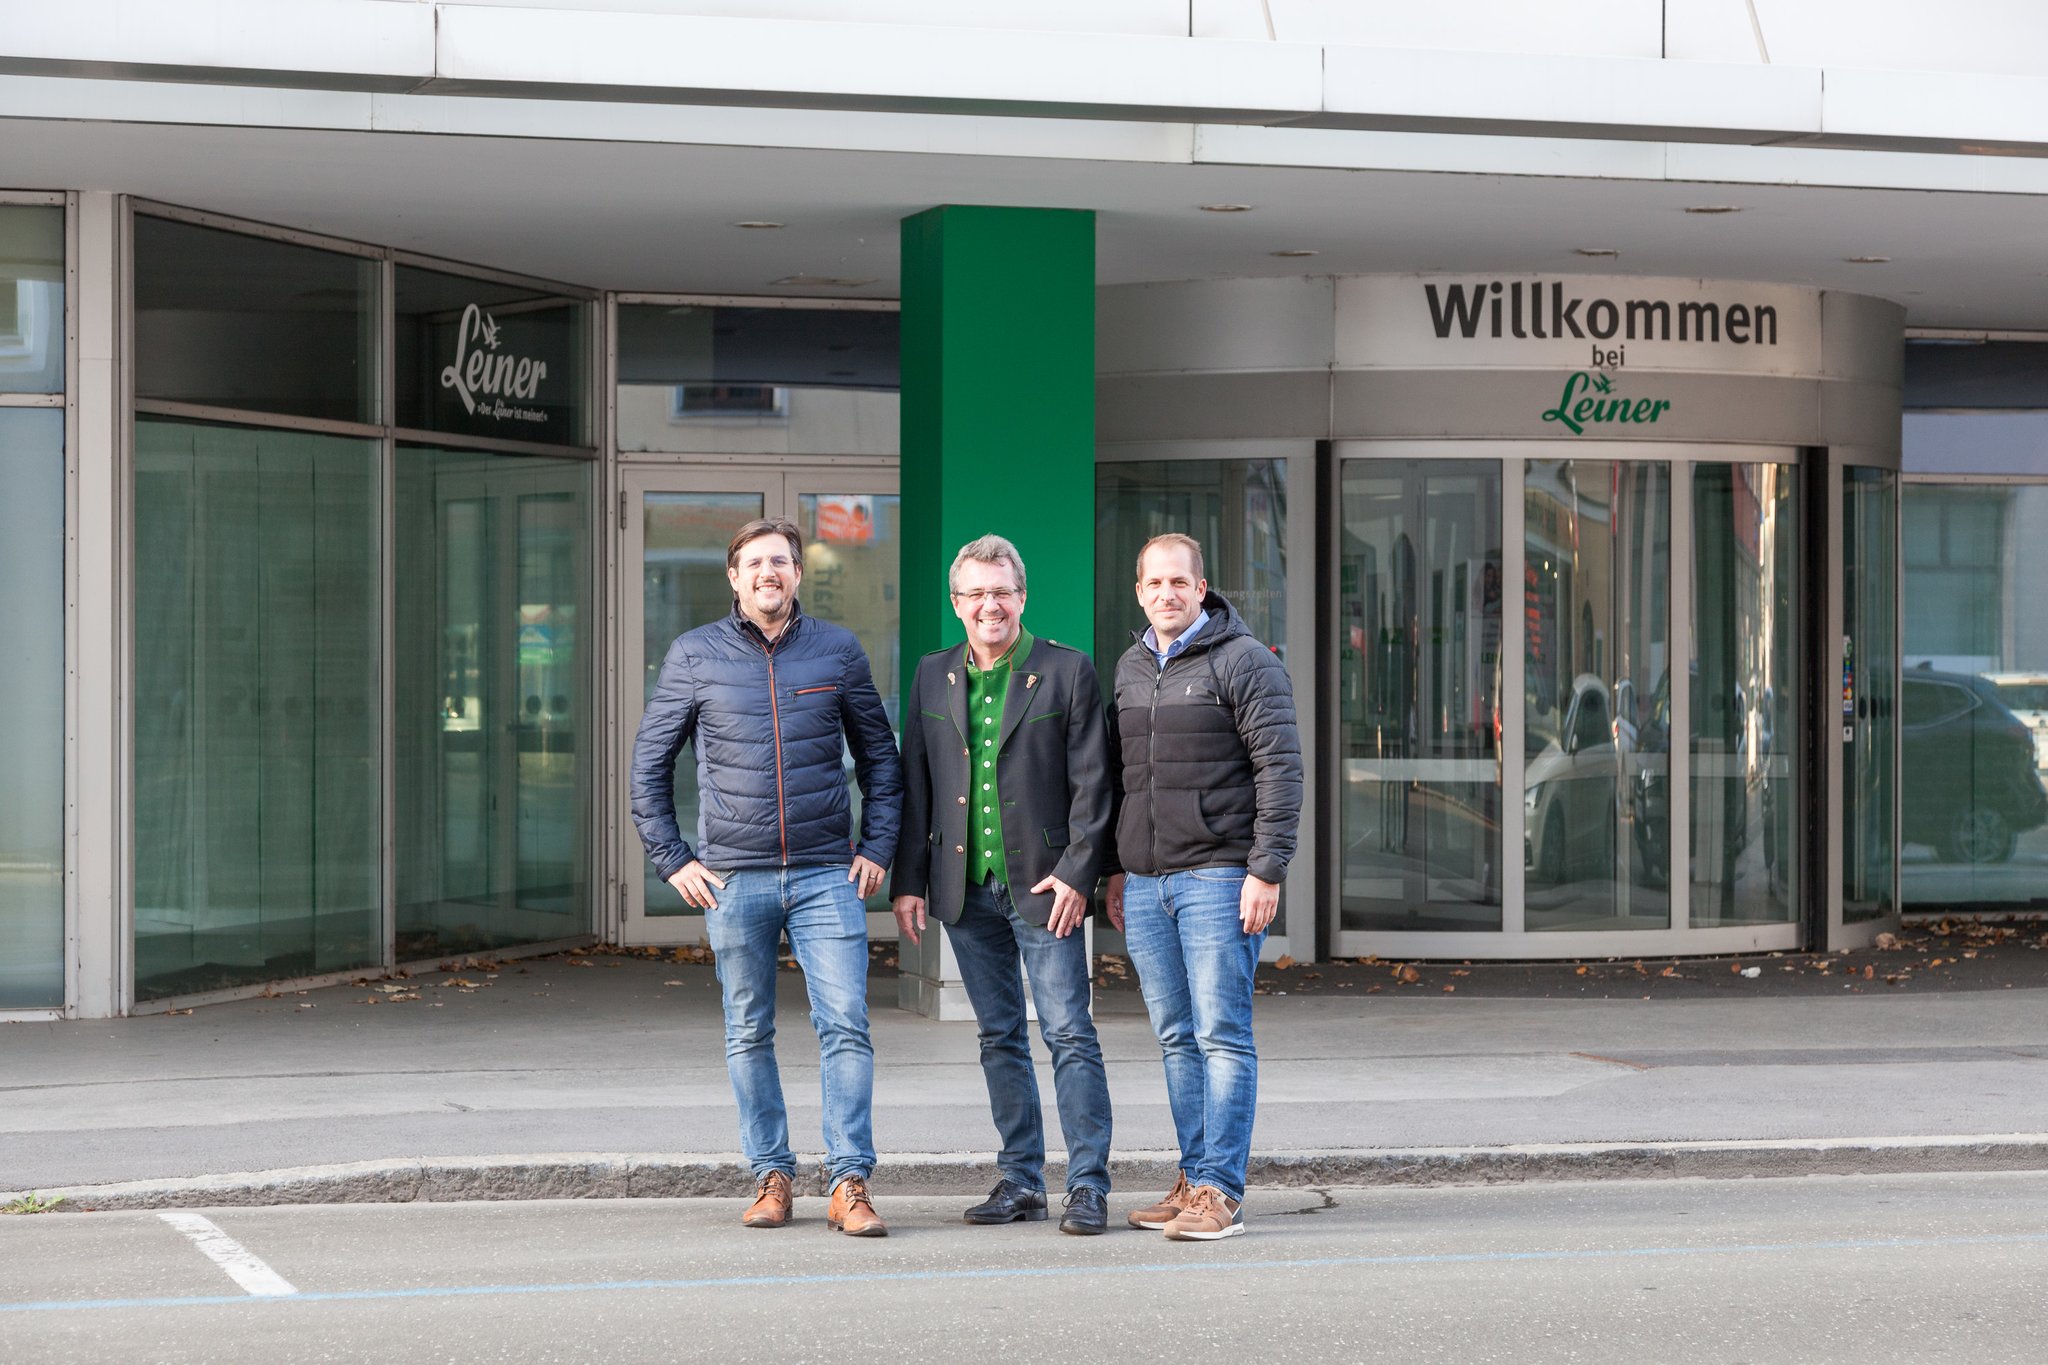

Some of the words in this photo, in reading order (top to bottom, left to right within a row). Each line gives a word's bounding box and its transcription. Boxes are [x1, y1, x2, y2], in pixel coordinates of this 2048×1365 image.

[1424, 281, 1778, 345] Willkommen
[441, 303, 547, 415] Leiner
[1592, 344, 1625, 367] bei
[1542, 371, 1670, 435] Leiner
